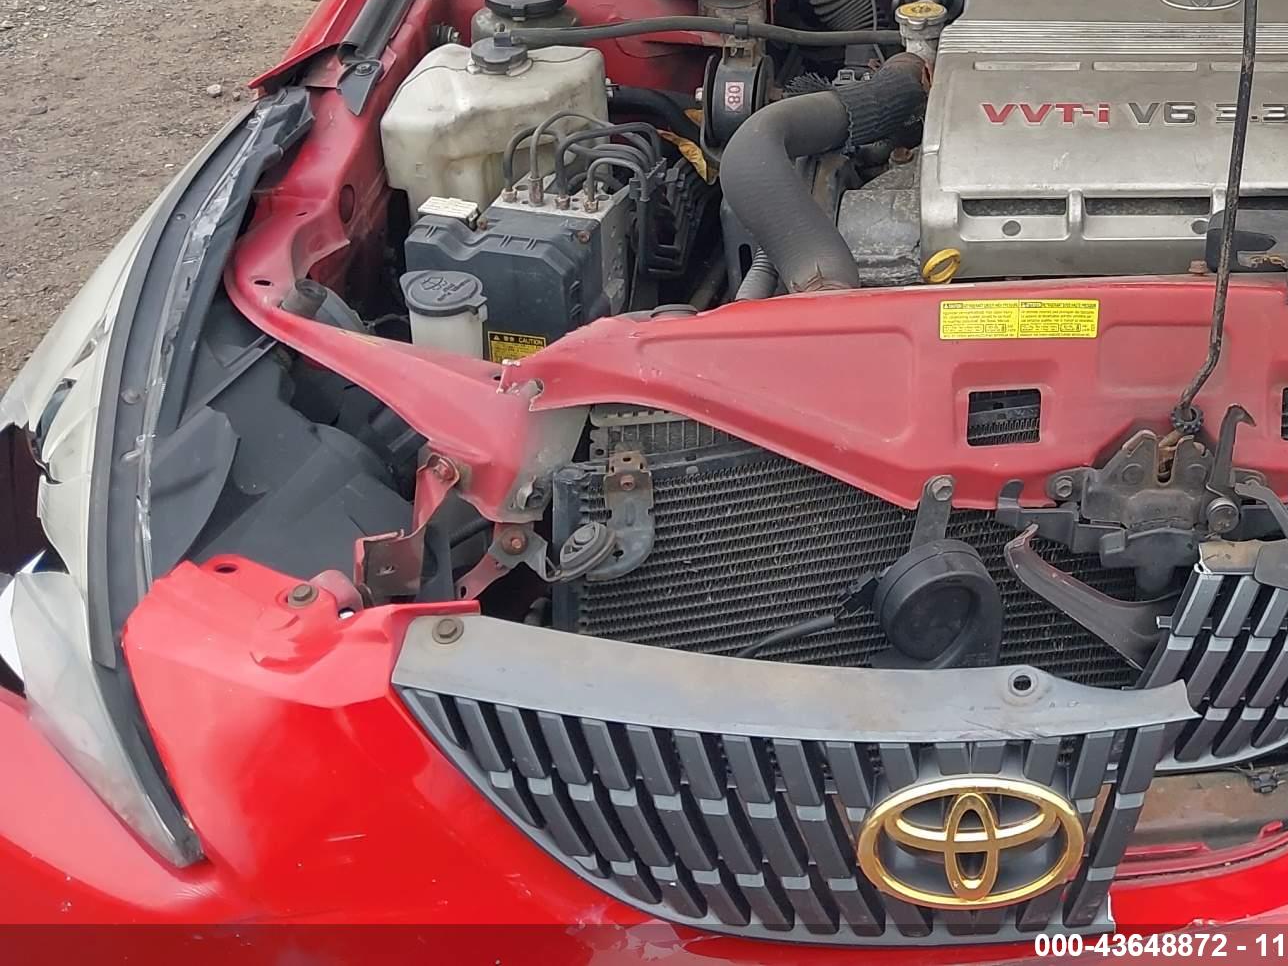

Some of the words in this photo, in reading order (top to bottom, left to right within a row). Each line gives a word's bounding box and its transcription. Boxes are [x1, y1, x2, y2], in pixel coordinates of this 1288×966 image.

[728, 86, 740, 104] 08
[982, 102, 1110, 125] VVT-i
[1128, 101, 1198, 125] V6
[518, 337, 543, 346] CAUTION
